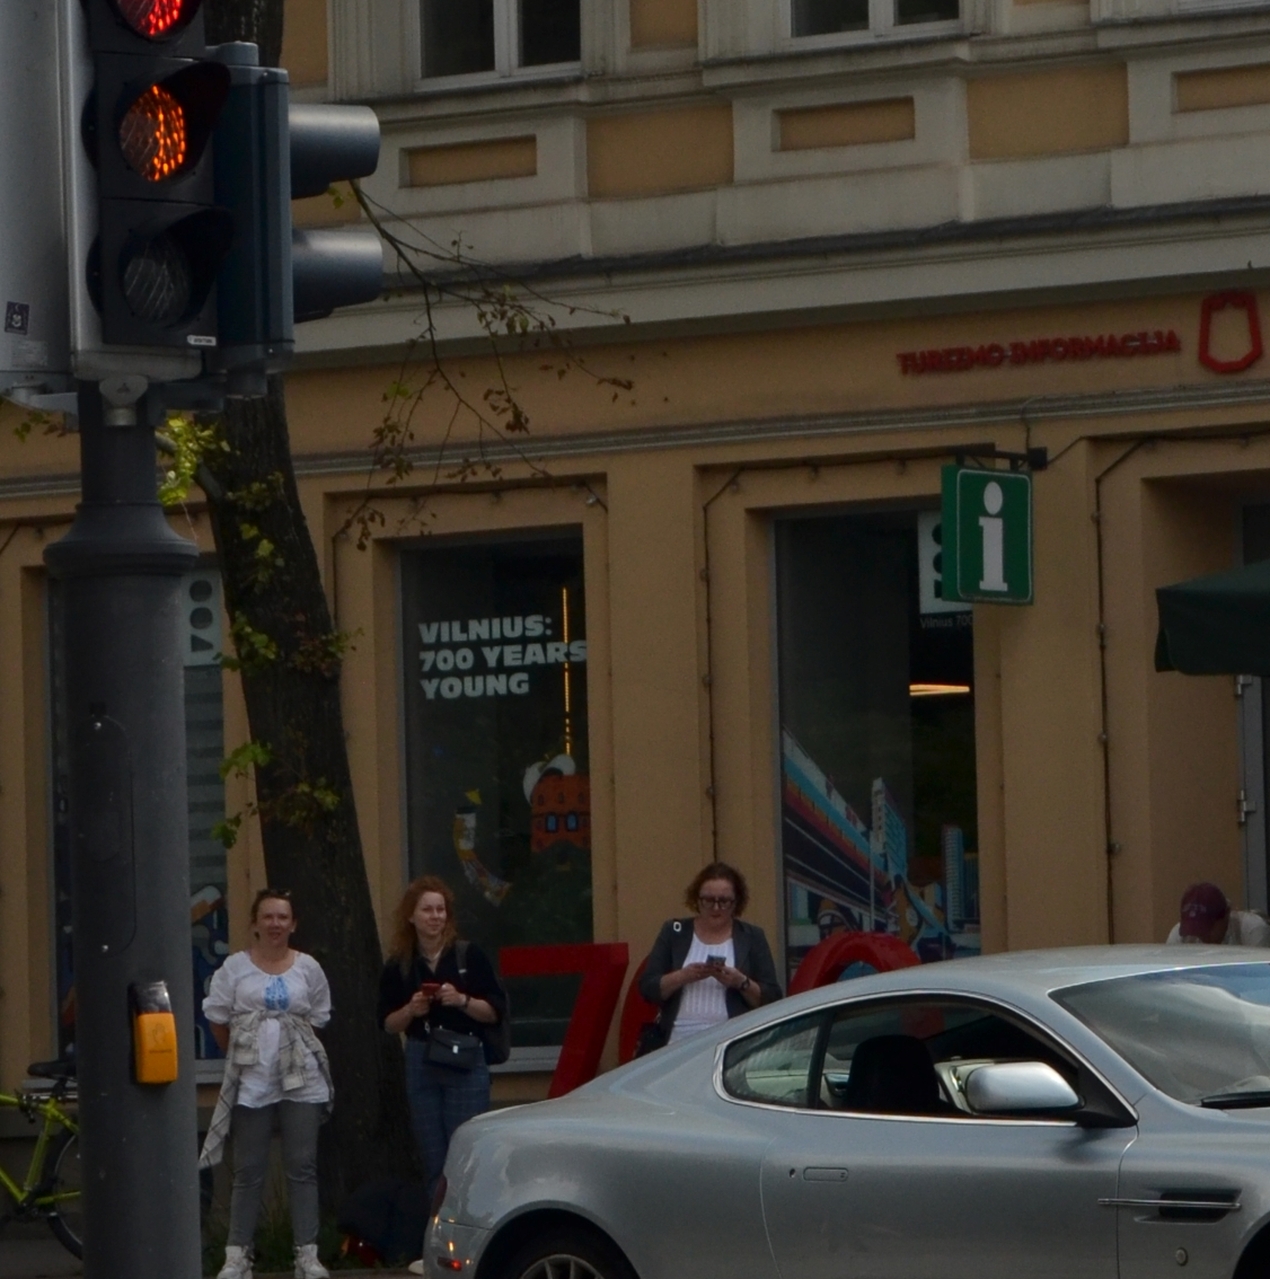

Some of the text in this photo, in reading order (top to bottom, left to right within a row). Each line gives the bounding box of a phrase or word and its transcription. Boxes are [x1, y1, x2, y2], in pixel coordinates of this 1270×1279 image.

[418, 614, 552, 644] VILNIUS:
[419, 639, 587, 672] 700 YEARS
[420, 672, 530, 700] YOUNG
